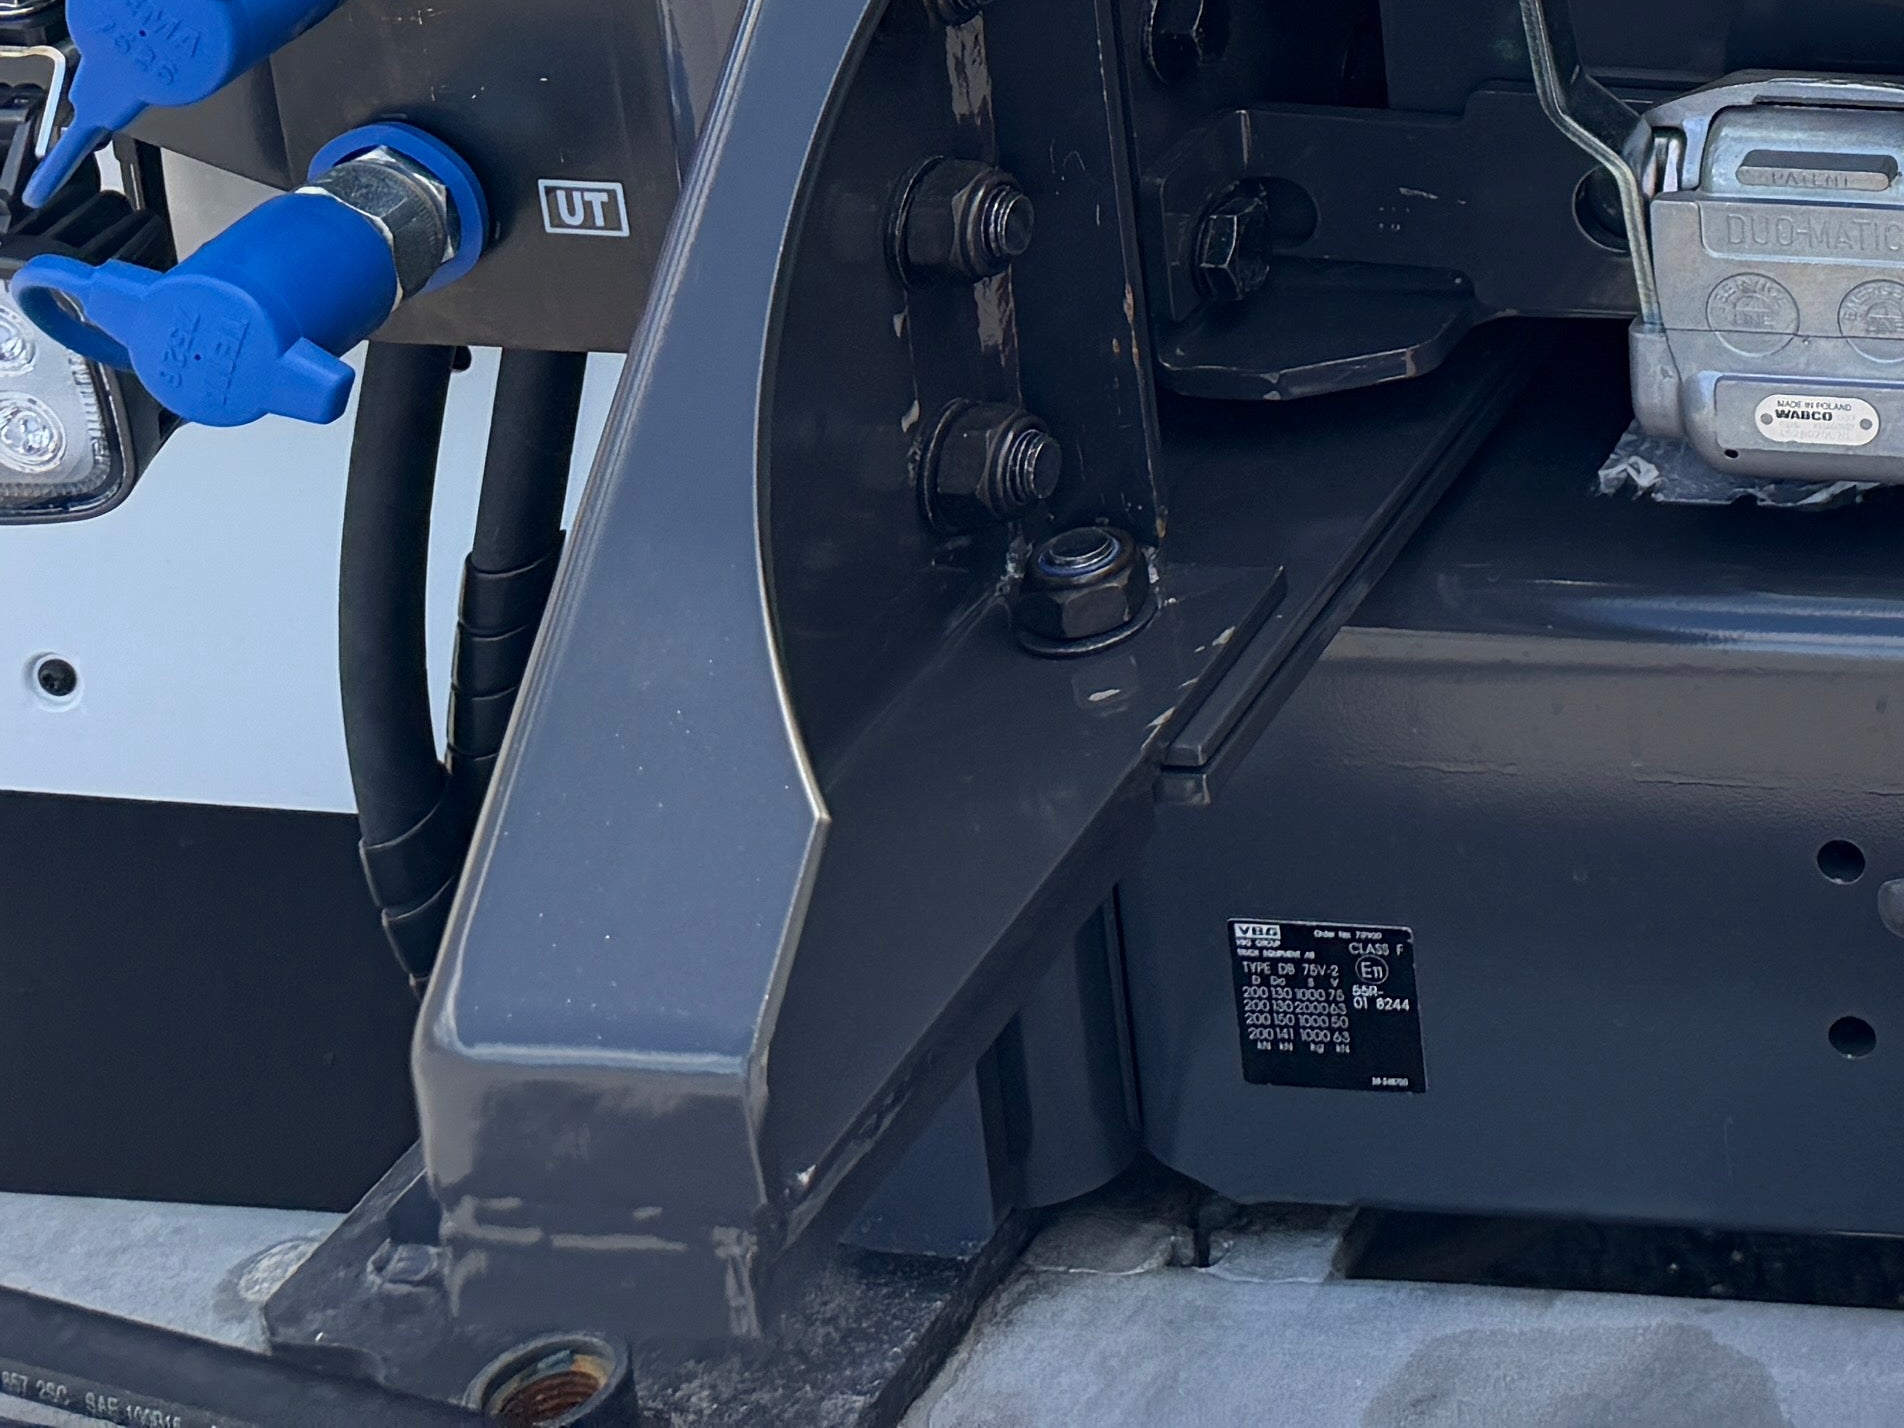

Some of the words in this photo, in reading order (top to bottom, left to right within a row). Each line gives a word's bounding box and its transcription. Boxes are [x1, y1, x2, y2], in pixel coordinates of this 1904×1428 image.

[555, 189, 610, 228] UT
[1726, 212, 1904, 252] DUO-MATIC
[1777, 400, 1801, 409] MADE
[1815, 403, 1853, 412] POLAND
[1774, 409, 1833, 422] WABCO
[1238, 925, 1279, 937] VBG
[1348, 941, 1390, 956] CLASS
[1395, 943, 1404, 957] F
[1242, 960, 1272, 975] TYPE
[1278, 962, 1296, 976] DB
[1251, 974, 1262, 985] D
[1242, 986, 1269, 998] 200
[1270, 986, 1293, 999] 130
[1294, 988, 1326, 1001] 1000
[1243, 999, 1270, 1012] 200
[1271, 999, 1294, 1012] 130
[1294, 1001, 1329, 1015] 2000
[1330, 1002, 1347, 1015] 63
[1353, 996, 1368, 1010] 01
[1376, 997, 1410, 1012] 8244
[1244, 1012, 1272, 1025] 200
[1273, 1012, 1295, 1026] 150
[1298, 1014, 1330, 1028] 1000
[1331, 1015, 1349, 1029] 50
[1247, 1026, 1274, 1040] 200
[1275, 1027, 1294, 1040] 141
[1299, 1028, 1331, 1042] 1000
[1332, 1030, 1350, 1043] 63
[84, 1391, 120, 1416] SAE
